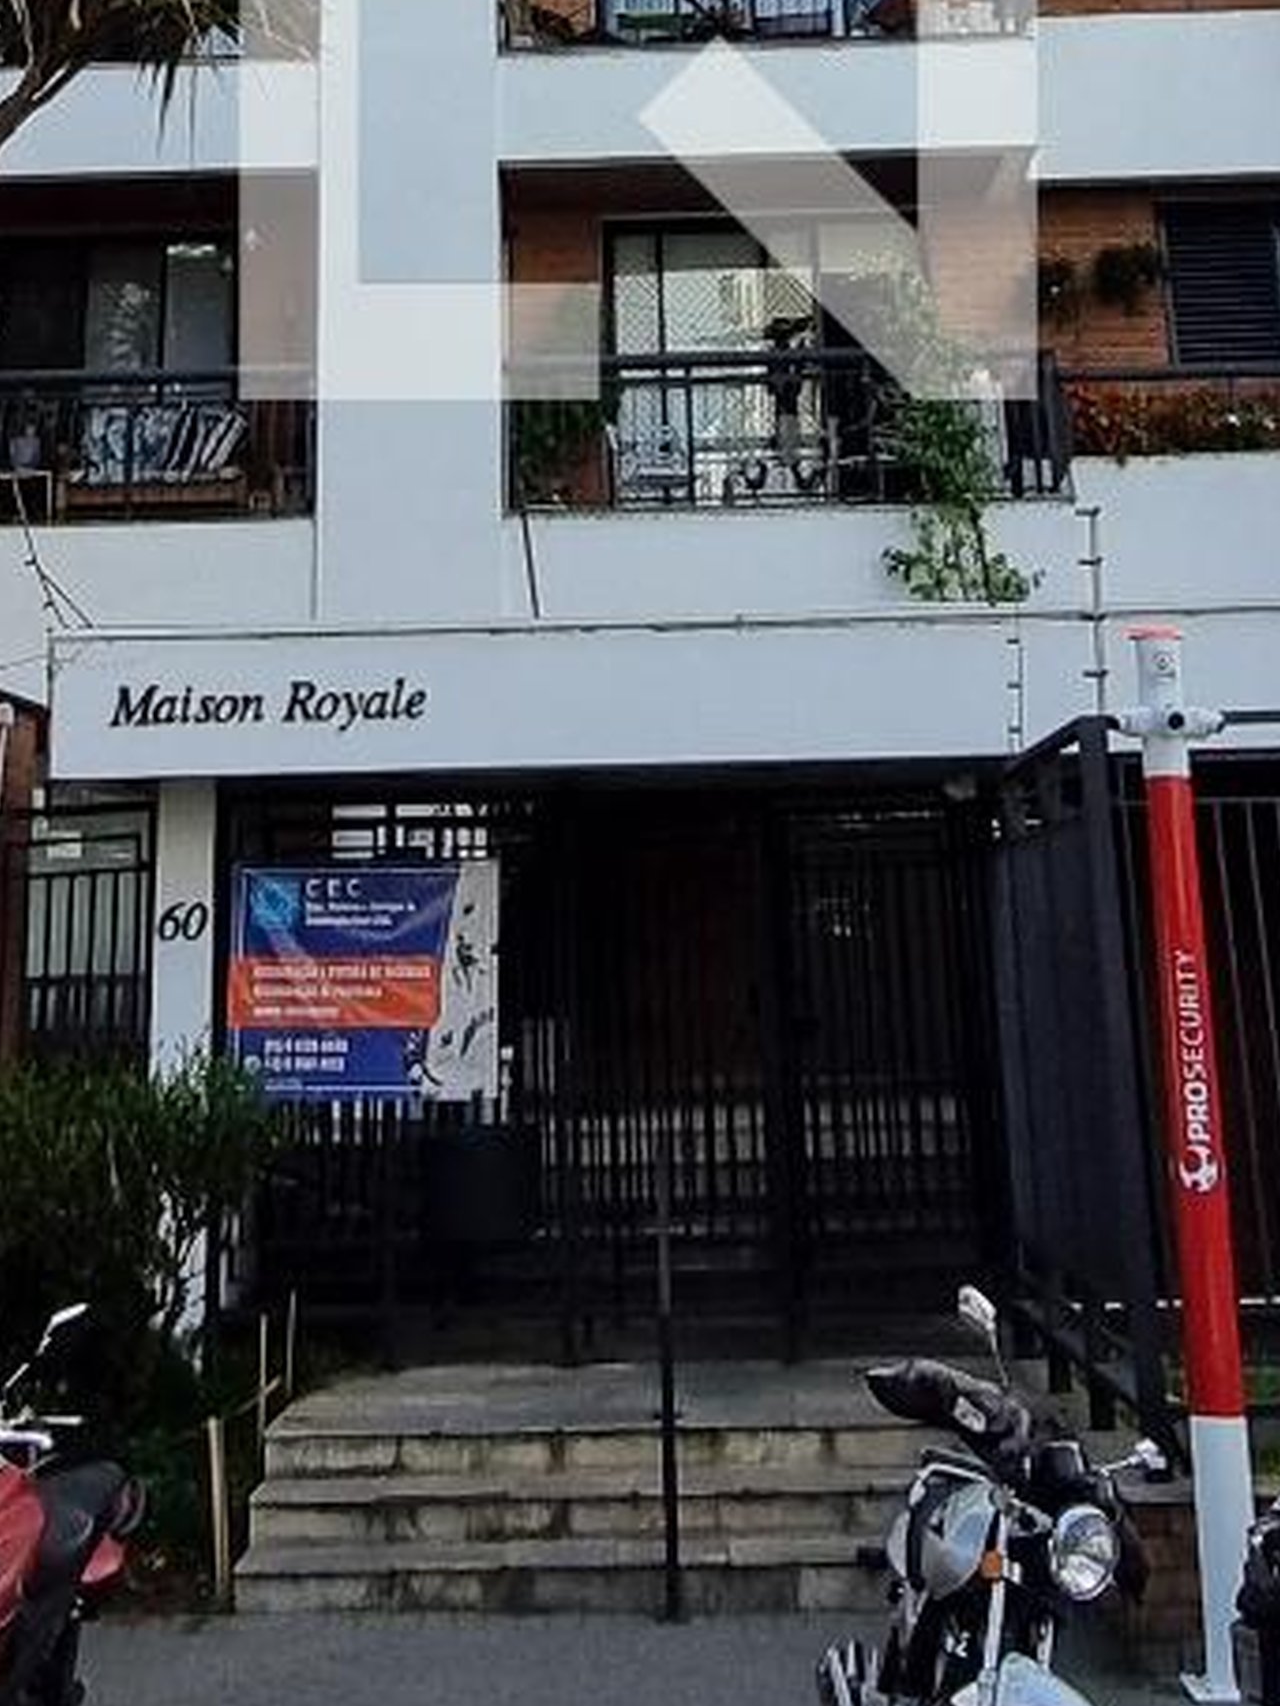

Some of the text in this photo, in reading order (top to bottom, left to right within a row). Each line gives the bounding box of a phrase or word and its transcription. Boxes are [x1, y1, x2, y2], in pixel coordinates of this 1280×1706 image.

[109, 677, 427, 732] Maison Royale
[159, 901, 208, 941] 60
[1175, 950, 1211, 1145] PROSECURITY
